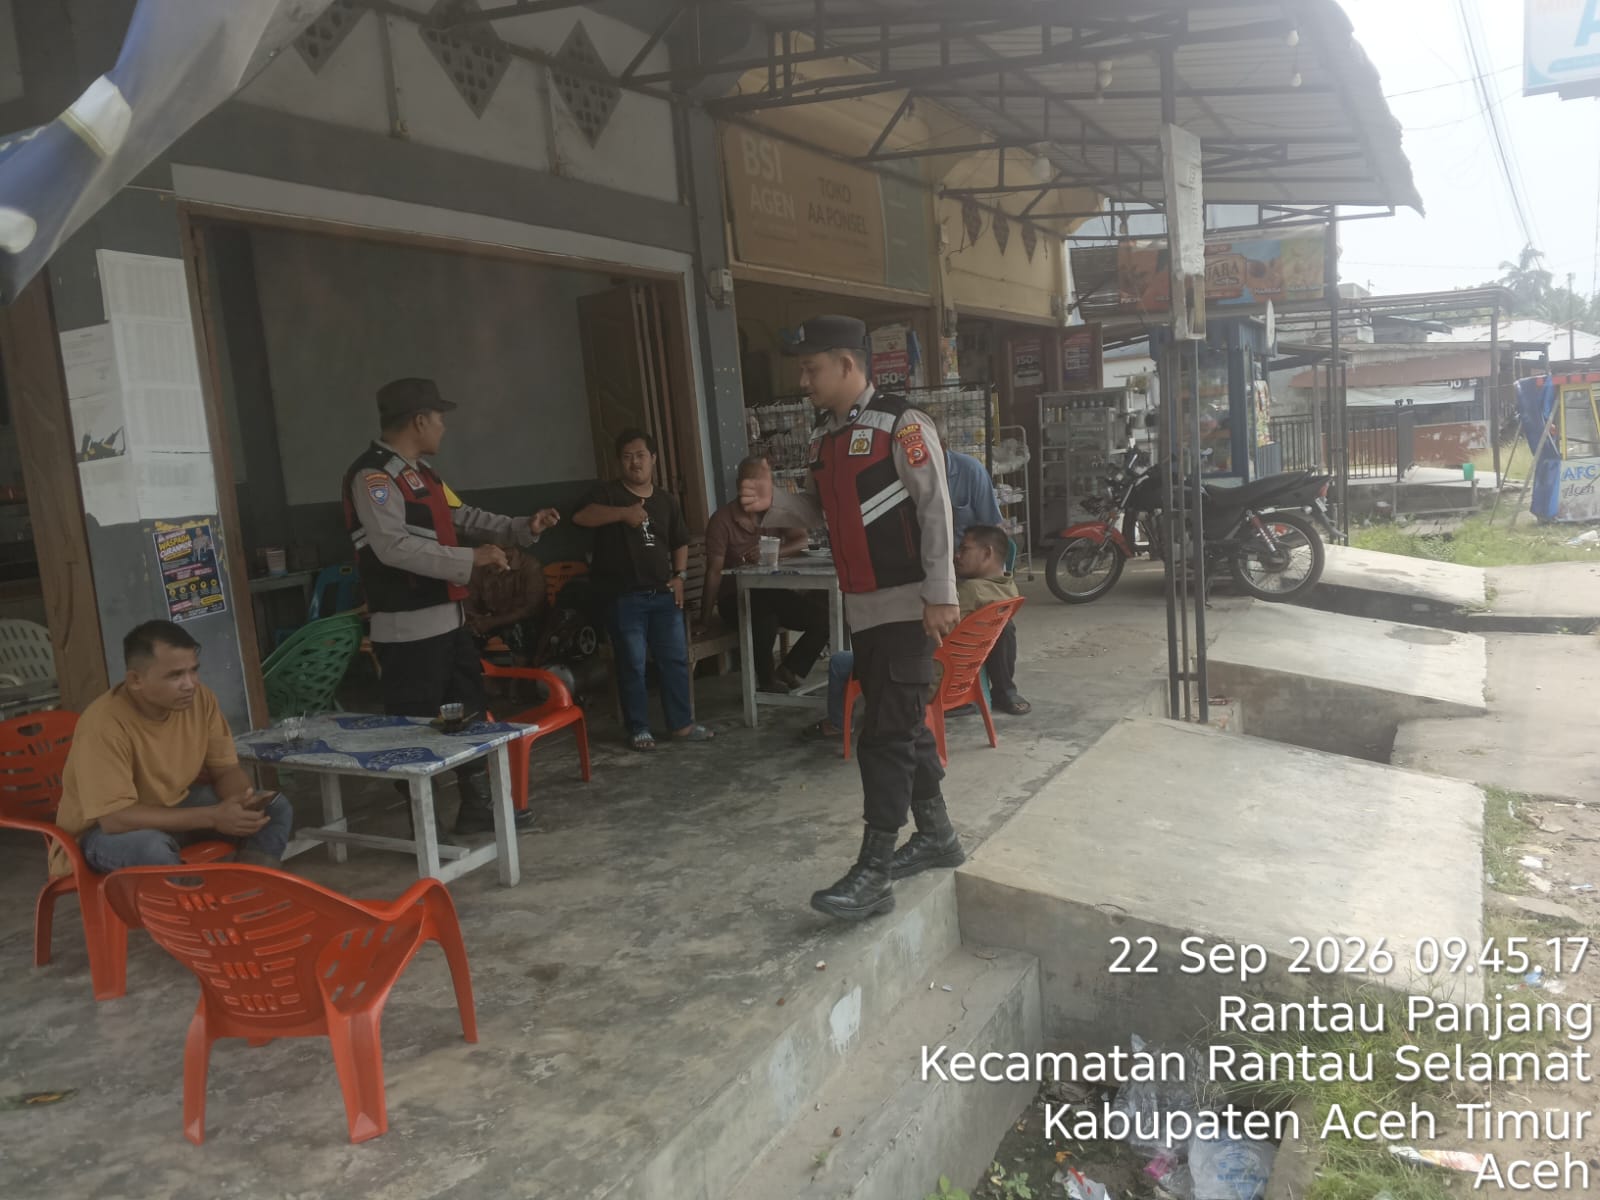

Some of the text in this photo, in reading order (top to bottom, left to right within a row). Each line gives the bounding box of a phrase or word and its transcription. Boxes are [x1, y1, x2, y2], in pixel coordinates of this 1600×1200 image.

[740, 132, 784, 183] BSI
[749, 184, 796, 221] AGEN
[817, 176, 852, 205] TOKO
[826, 208, 869, 235] PONSEL
[876, 372, 899, 386] 150
